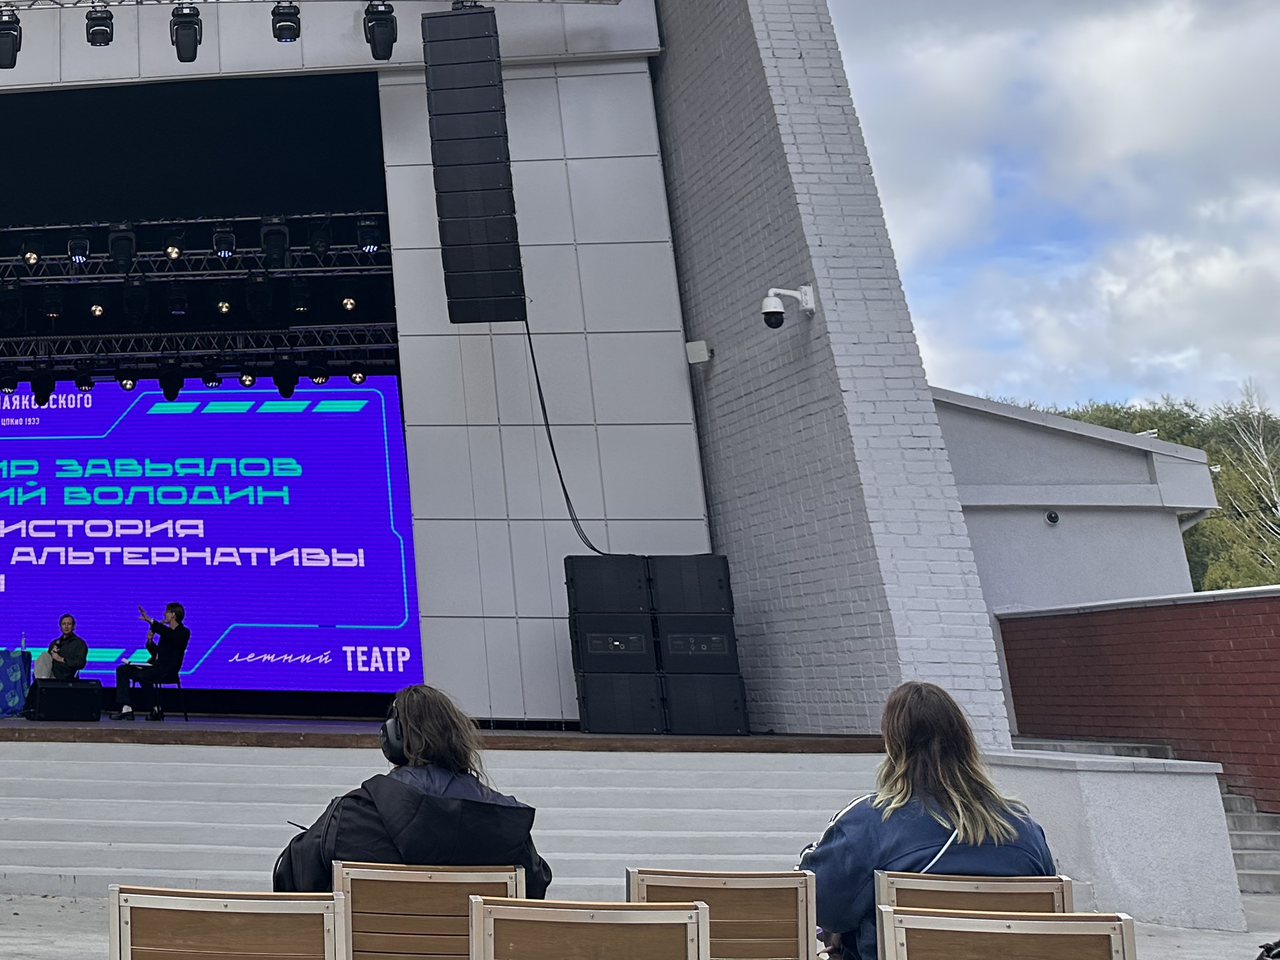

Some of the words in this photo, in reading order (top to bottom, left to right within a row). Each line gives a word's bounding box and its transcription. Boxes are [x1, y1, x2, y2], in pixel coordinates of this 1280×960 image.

[24, 417, 41, 426] 1933
[55, 457, 304, 479] ЗАВЬЯЛОВ
[63, 485, 290, 506] ВОЛОДИН
[0, 519, 205, 538] ИСТОРИЯ
[10, 546, 366, 568] АЛЬТЕРНАТИВЫ
[228, 650, 333, 665] летний
[341, 645, 412, 673] ТЕАТР
